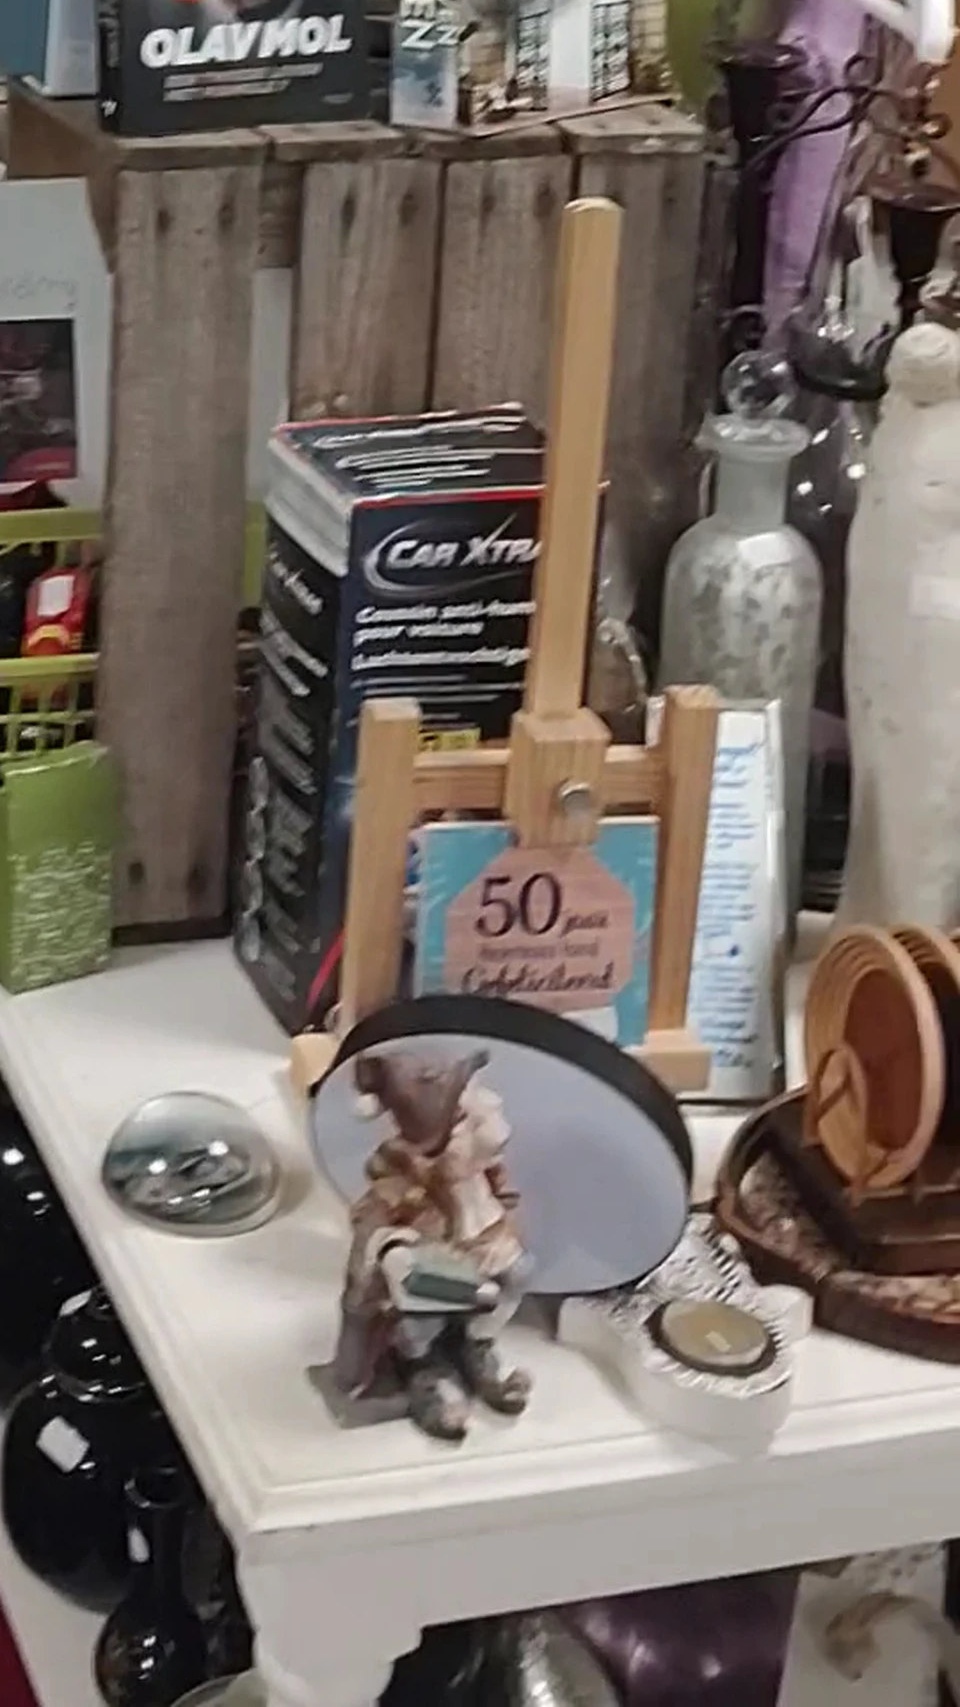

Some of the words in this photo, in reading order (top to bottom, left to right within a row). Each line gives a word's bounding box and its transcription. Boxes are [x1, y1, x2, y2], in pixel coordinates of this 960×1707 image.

[140, 21, 264, 69] OLAV
[257, 13, 354, 59] MOL
[385, 539, 460, 570] CAR
[474, 871, 563, 939] 50
